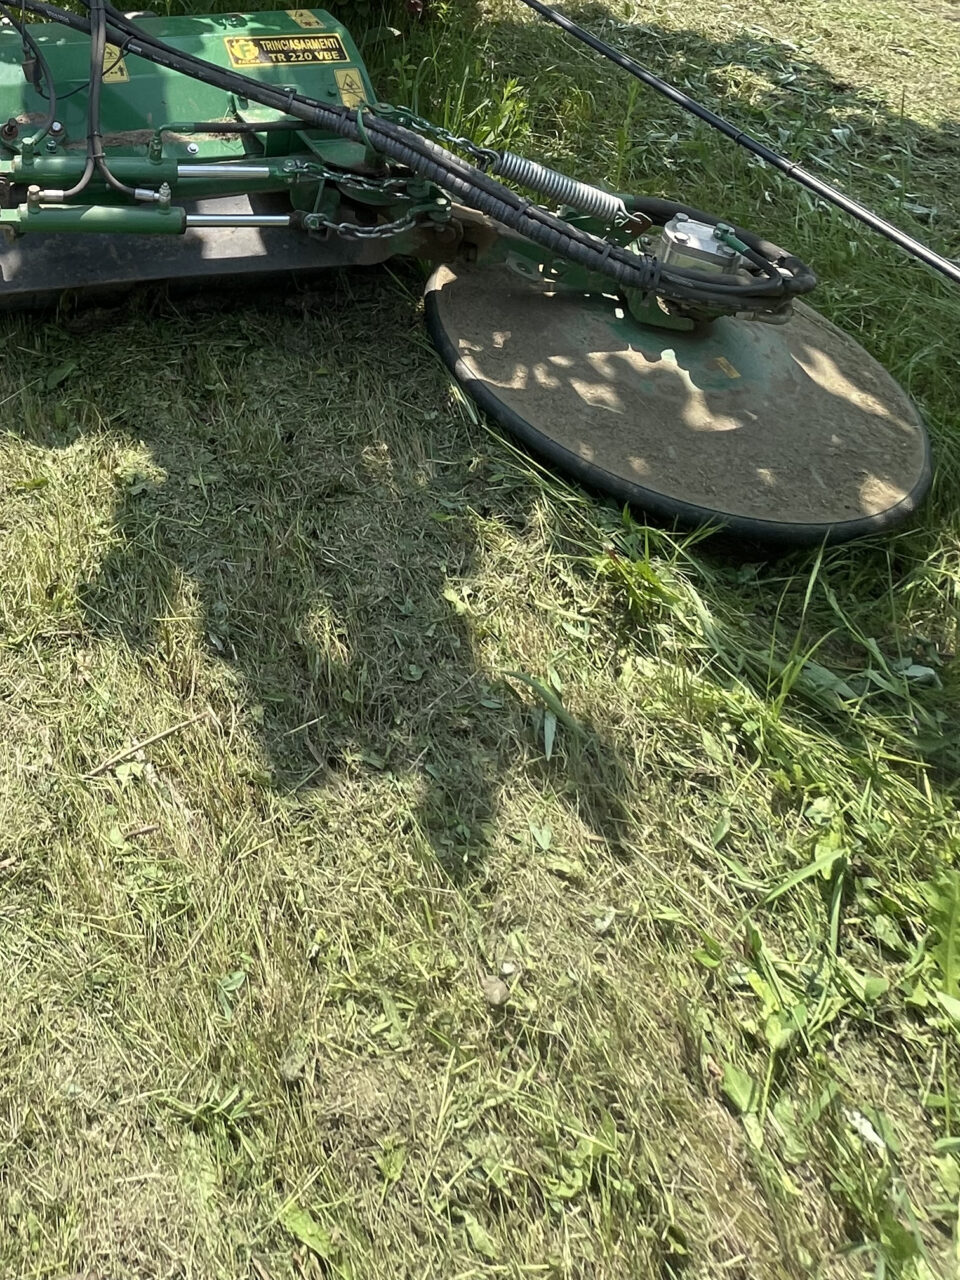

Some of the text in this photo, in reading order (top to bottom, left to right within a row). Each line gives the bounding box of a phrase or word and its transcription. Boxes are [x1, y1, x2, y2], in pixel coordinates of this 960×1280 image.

[260, 38, 339, 51] TRINCIASARMENTI
[269, 51, 340, 62] TR 220 VBE
